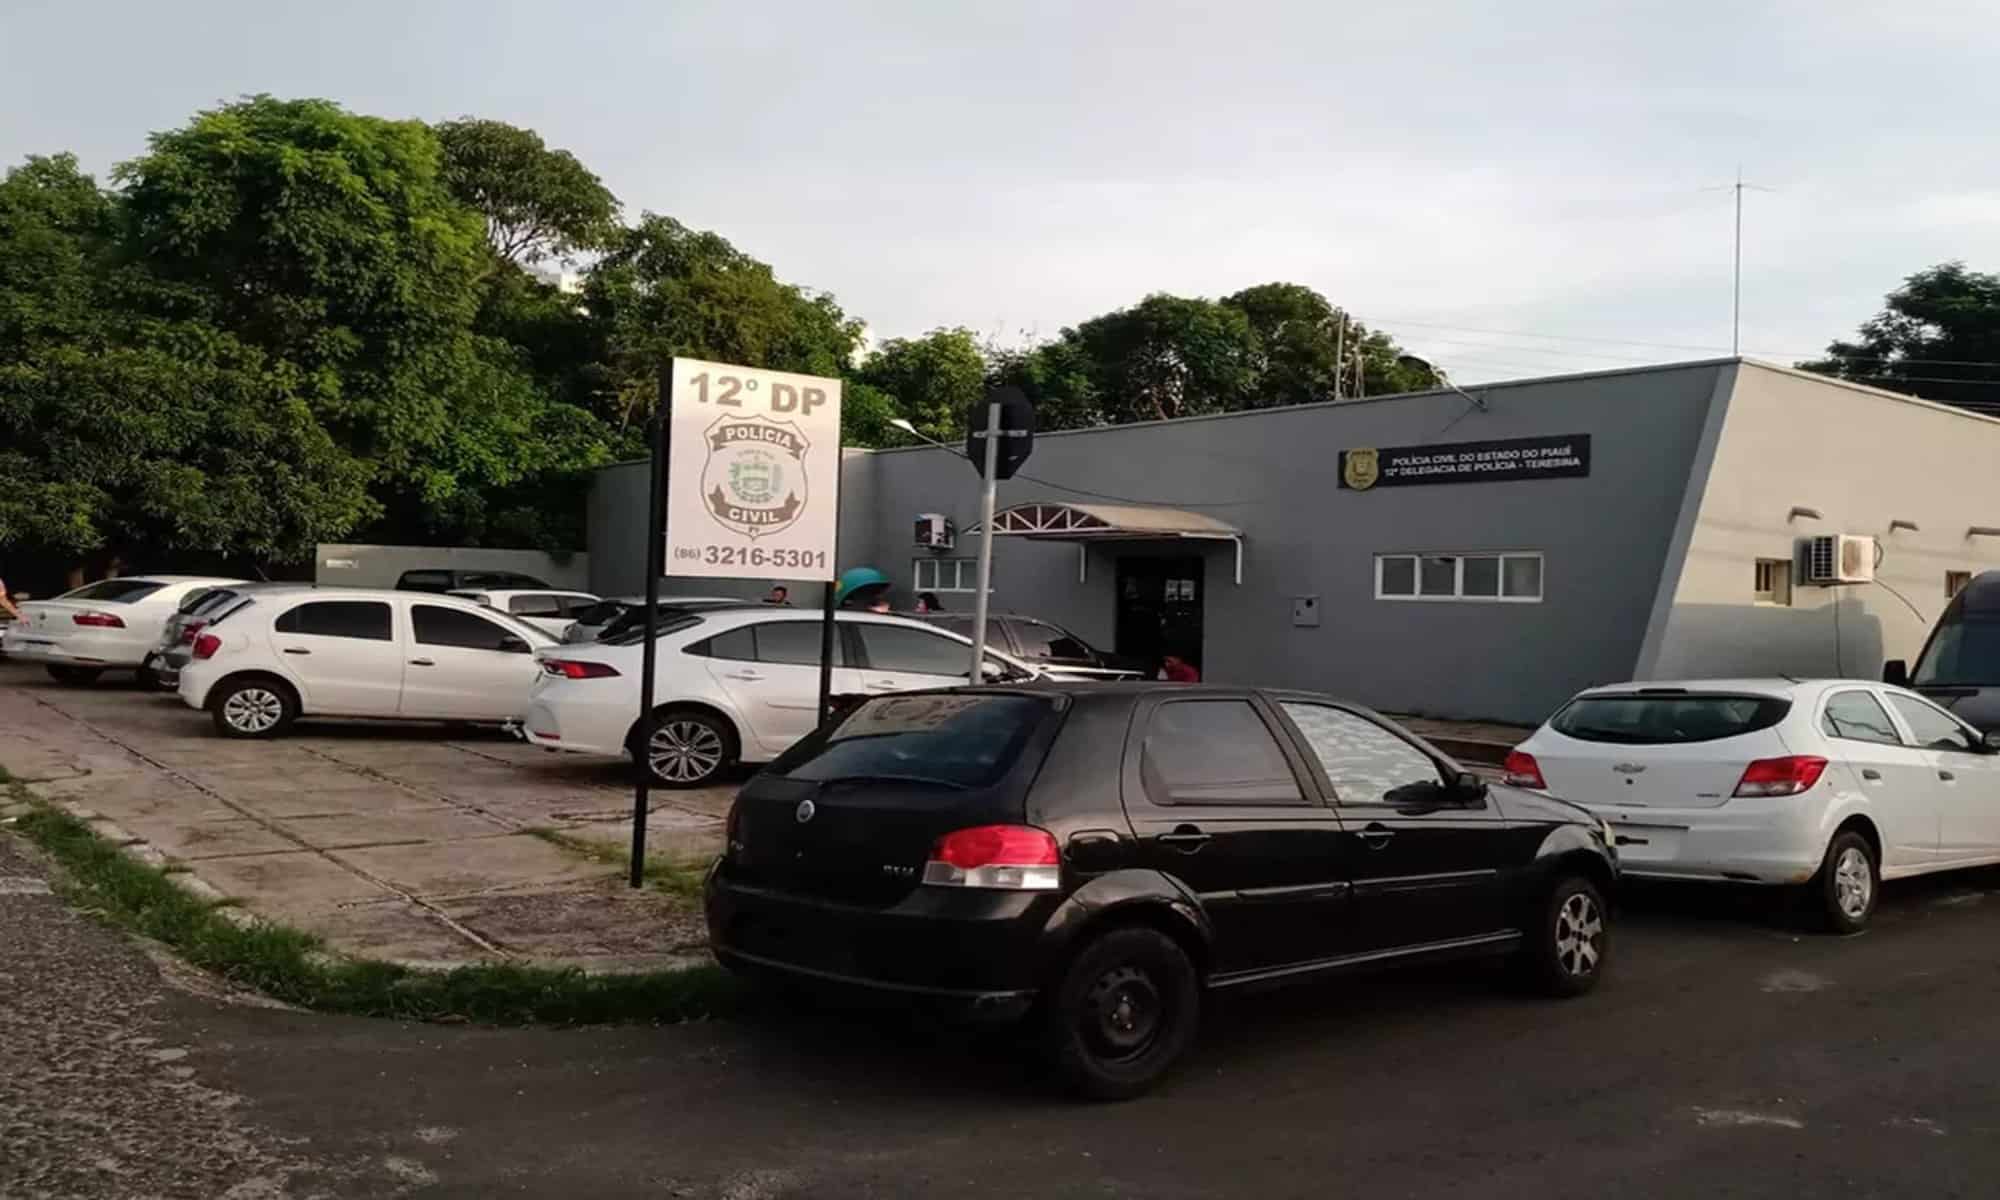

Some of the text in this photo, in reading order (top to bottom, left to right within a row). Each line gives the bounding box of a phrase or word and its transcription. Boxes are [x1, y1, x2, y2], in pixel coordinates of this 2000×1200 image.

[771, 382, 827, 416] DP
[1459, 452, 1475, 462] DO
[1477, 449, 1520, 461] ESTADO
[1522, 449, 1539, 459] DO
[1457, 463, 1472, 473] DE
[728, 508, 780, 523] CIVIL
[674, 544, 826, 569] (86) 3216-5301
